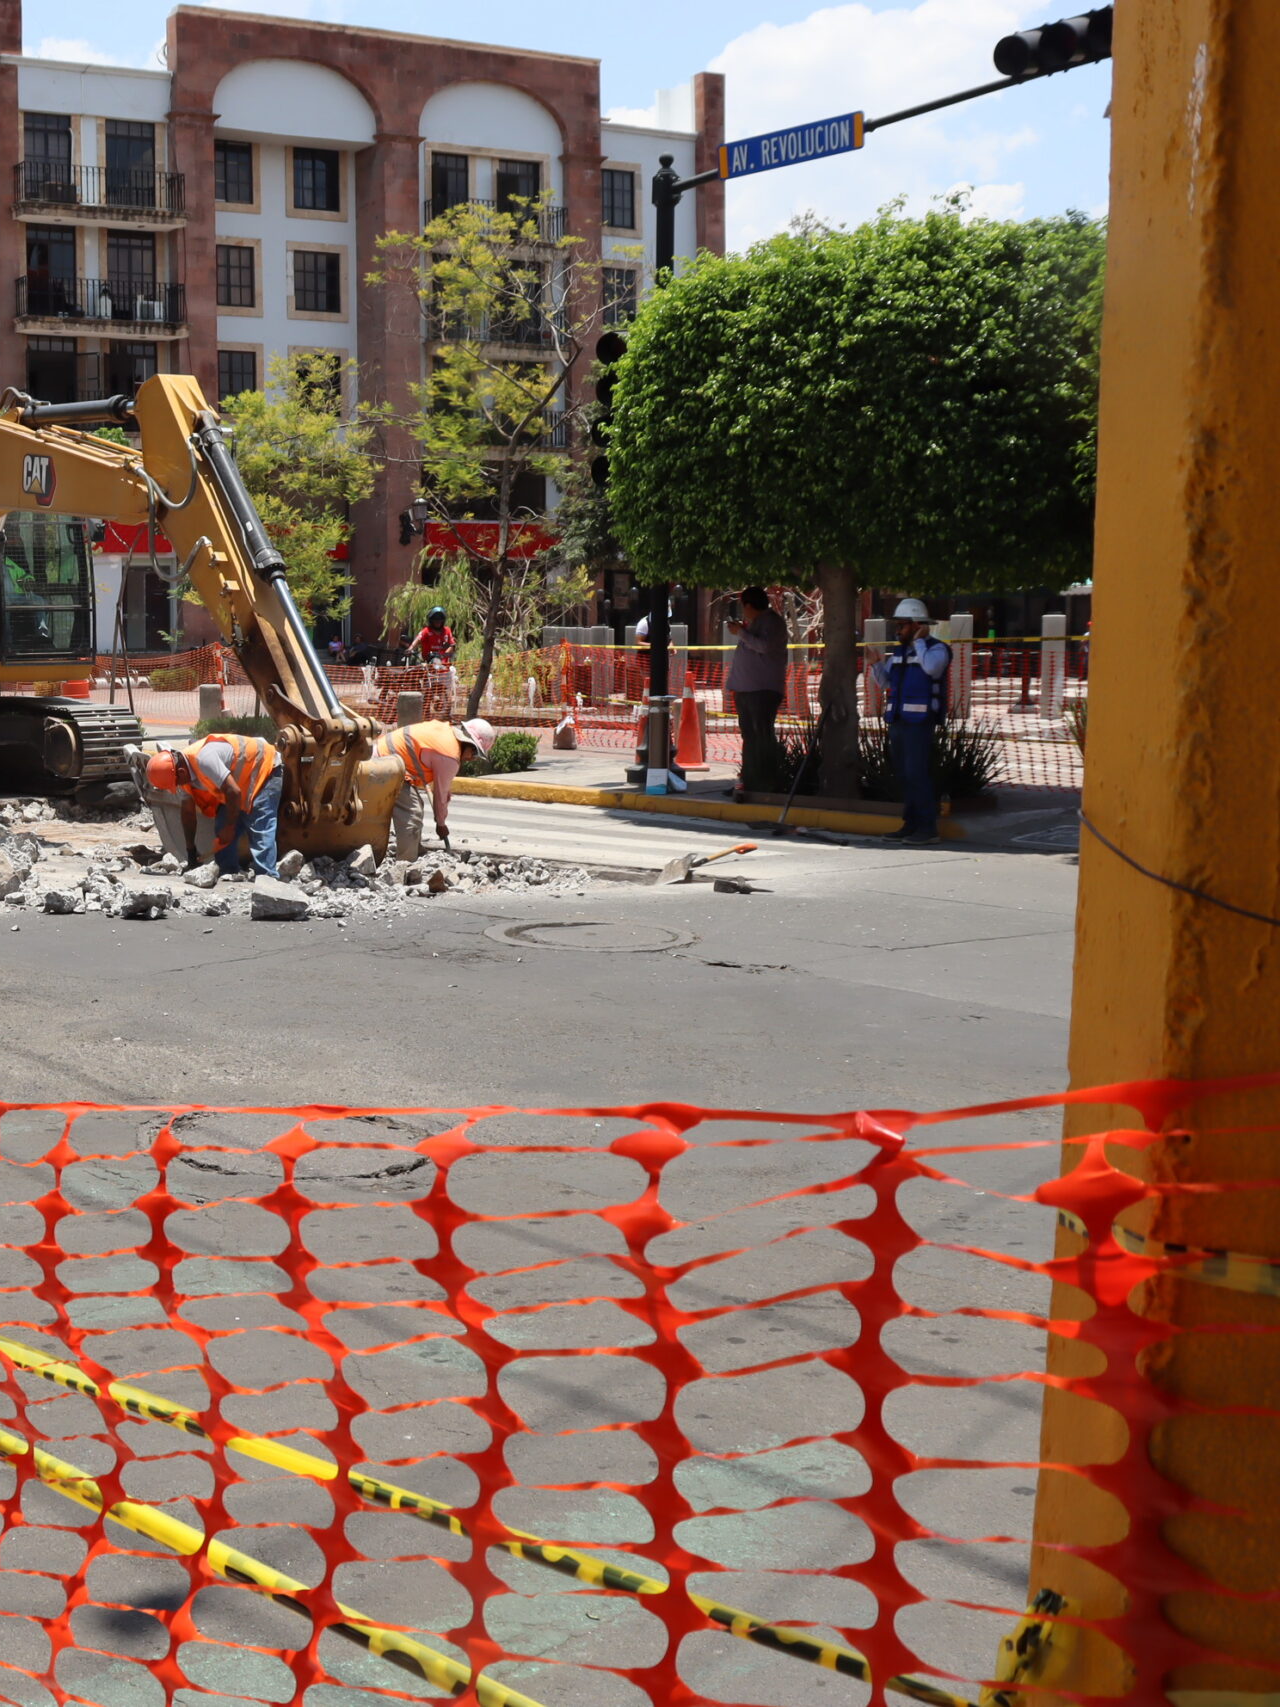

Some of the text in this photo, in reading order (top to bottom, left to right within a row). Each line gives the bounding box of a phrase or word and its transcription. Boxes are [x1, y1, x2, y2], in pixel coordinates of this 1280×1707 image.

[732, 119, 849, 173] AV. REVOLUCION
[23, 455, 49, 494] CAT
